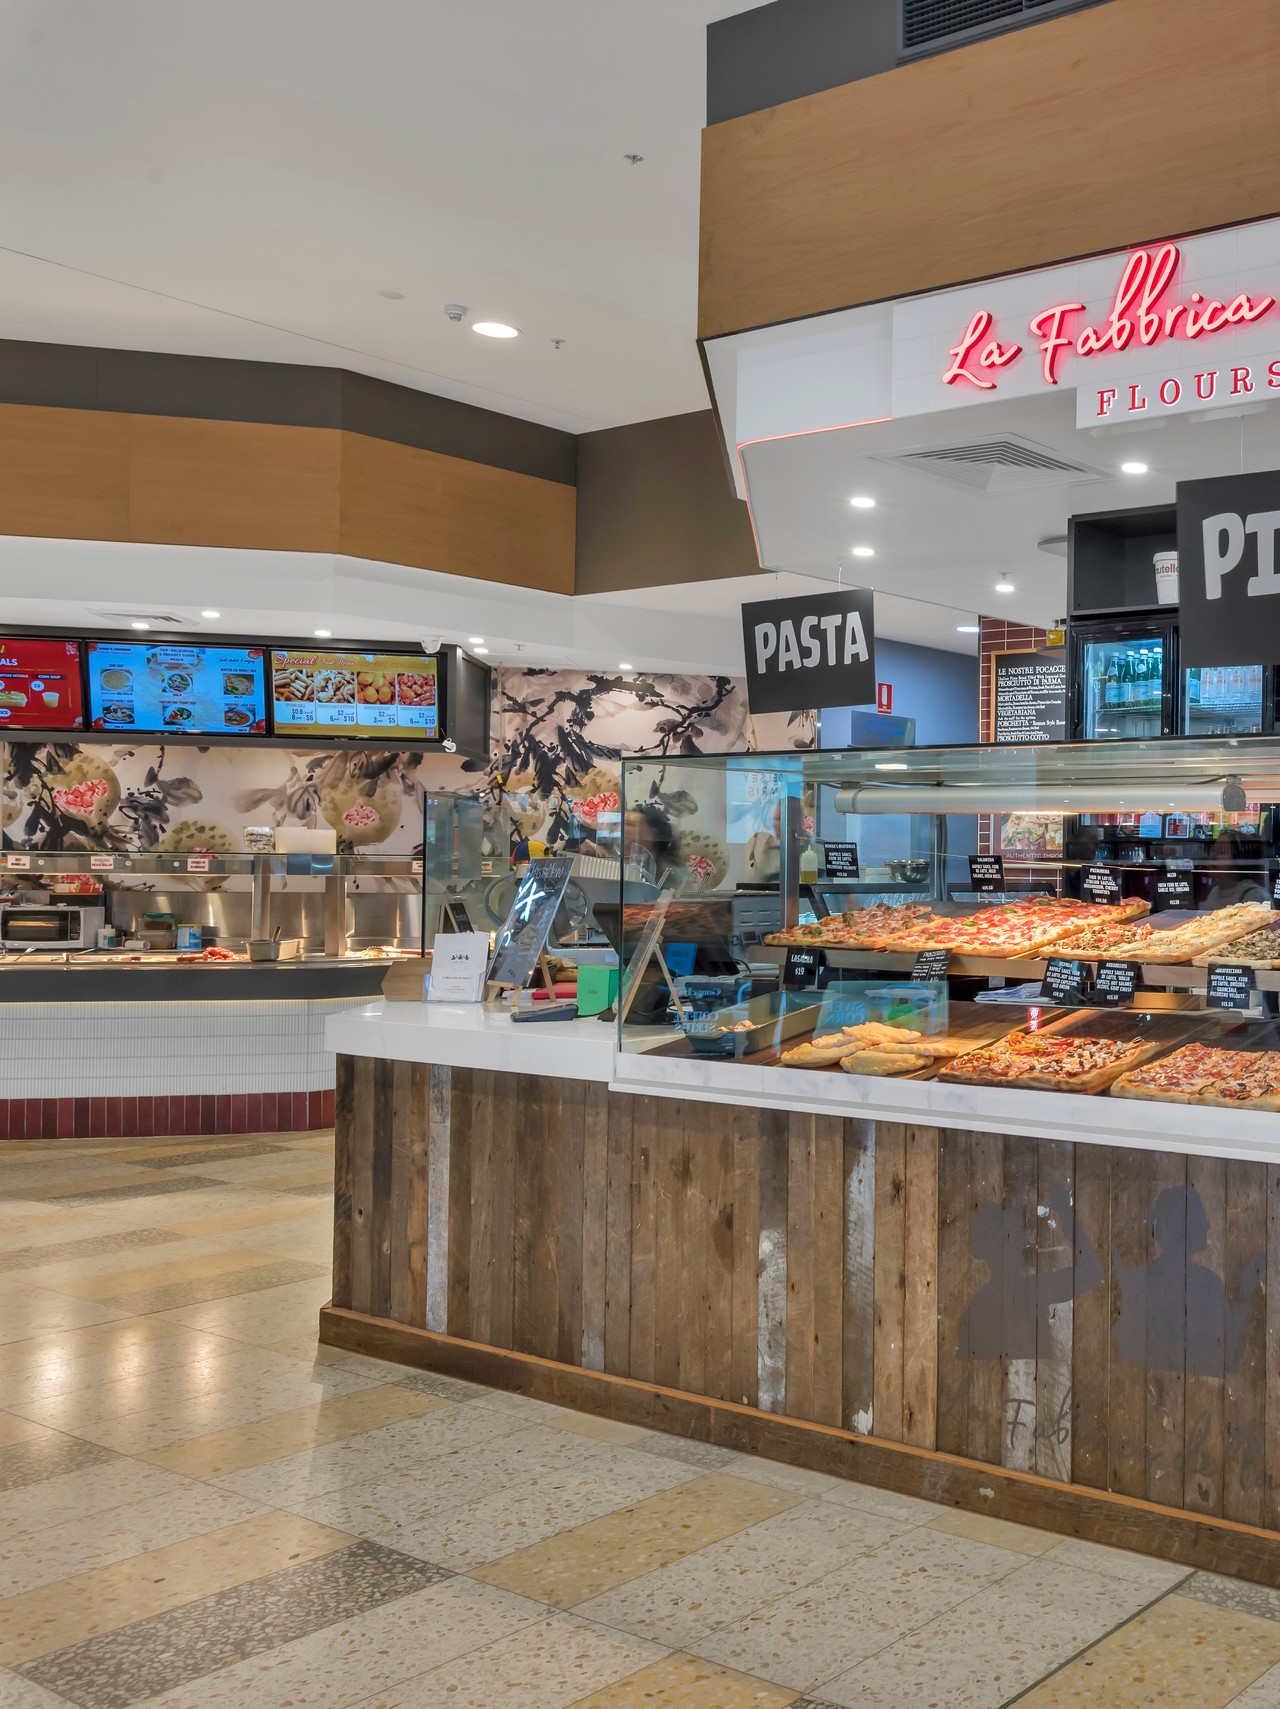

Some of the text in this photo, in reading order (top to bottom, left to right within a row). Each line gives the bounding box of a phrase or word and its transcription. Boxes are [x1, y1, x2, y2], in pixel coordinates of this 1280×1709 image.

[942, 309, 1021, 390] La
[1029, 242, 1275, 385] Fabbrica
[275, 655, 317, 667] Special
[754, 611, 869, 674] PASTA
[791, 955, 813, 963] LASAGNA
